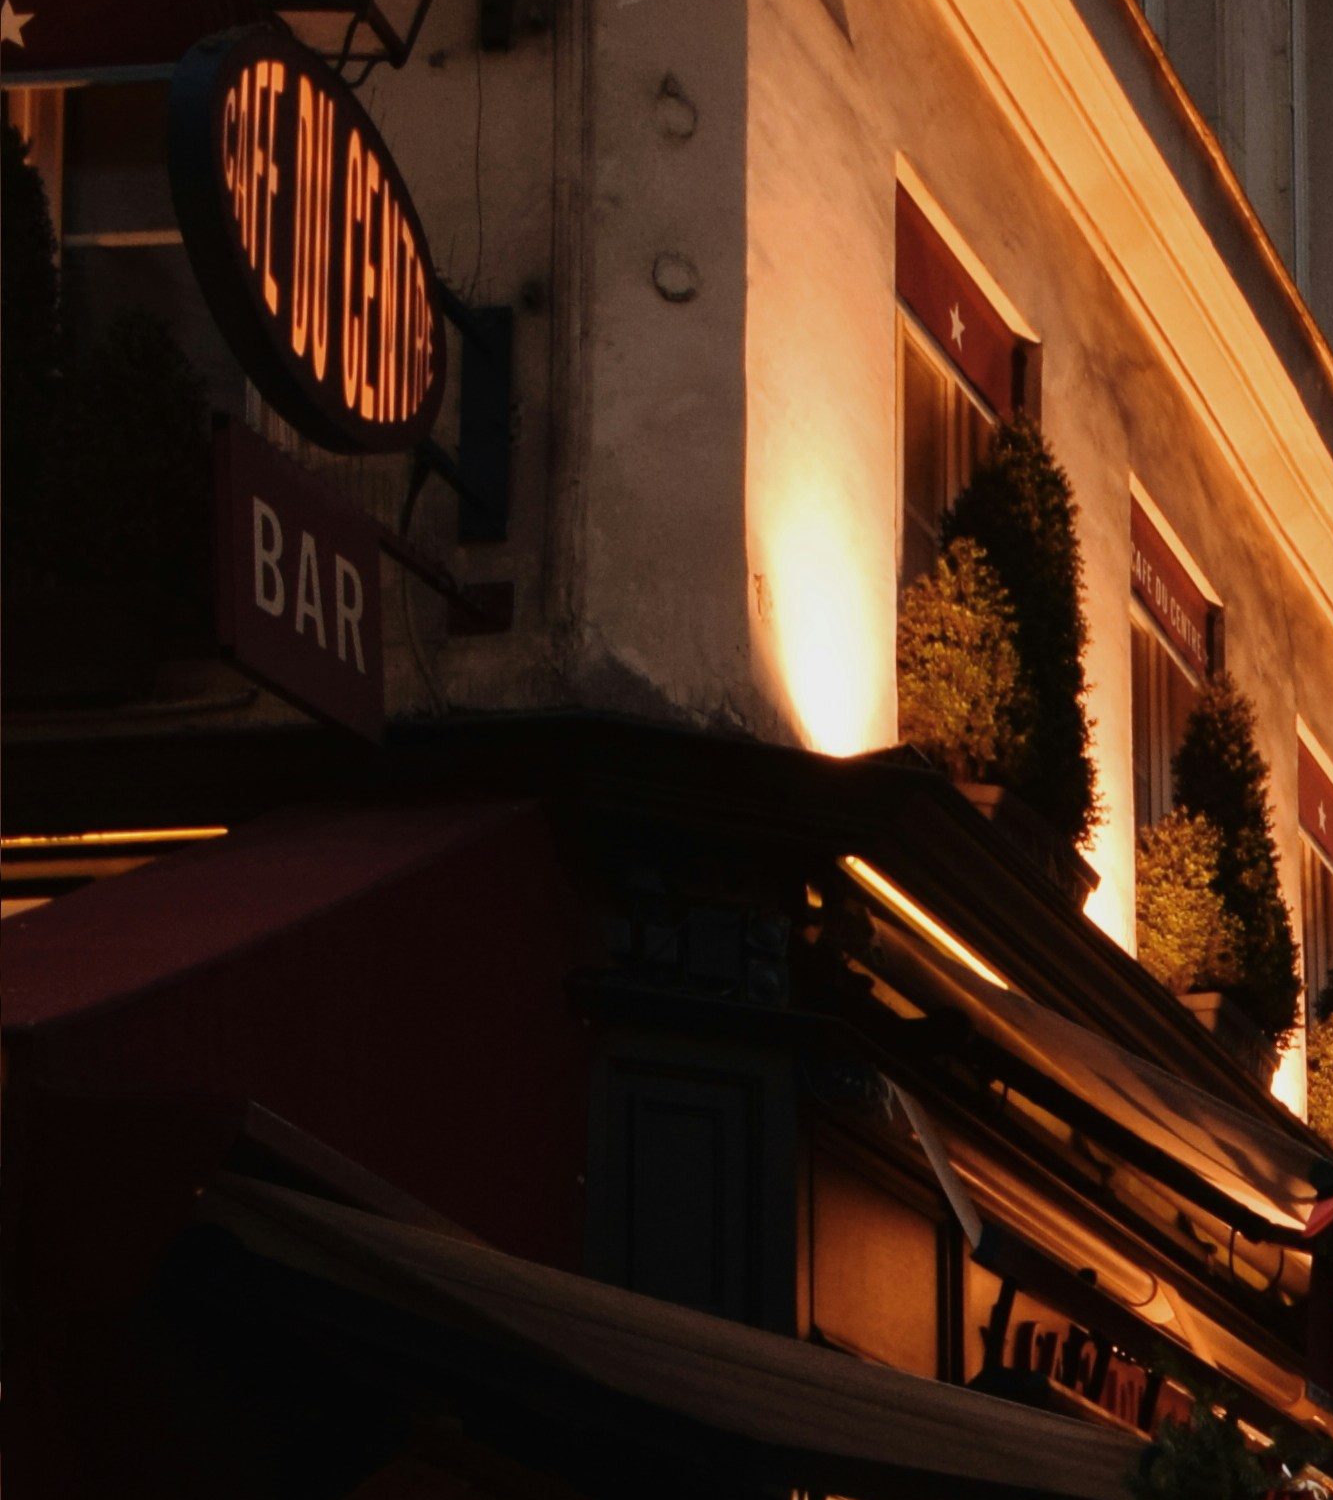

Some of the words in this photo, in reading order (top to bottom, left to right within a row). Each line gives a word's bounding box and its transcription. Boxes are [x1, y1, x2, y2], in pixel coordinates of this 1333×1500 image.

[291, 72, 335, 382] DU
[342, 127, 434, 423] CENTRE
[251, 495, 367, 675] BAR
[1155, 574, 1169, 616] DU
[1169, 596, 1203, 662] CENTRE
